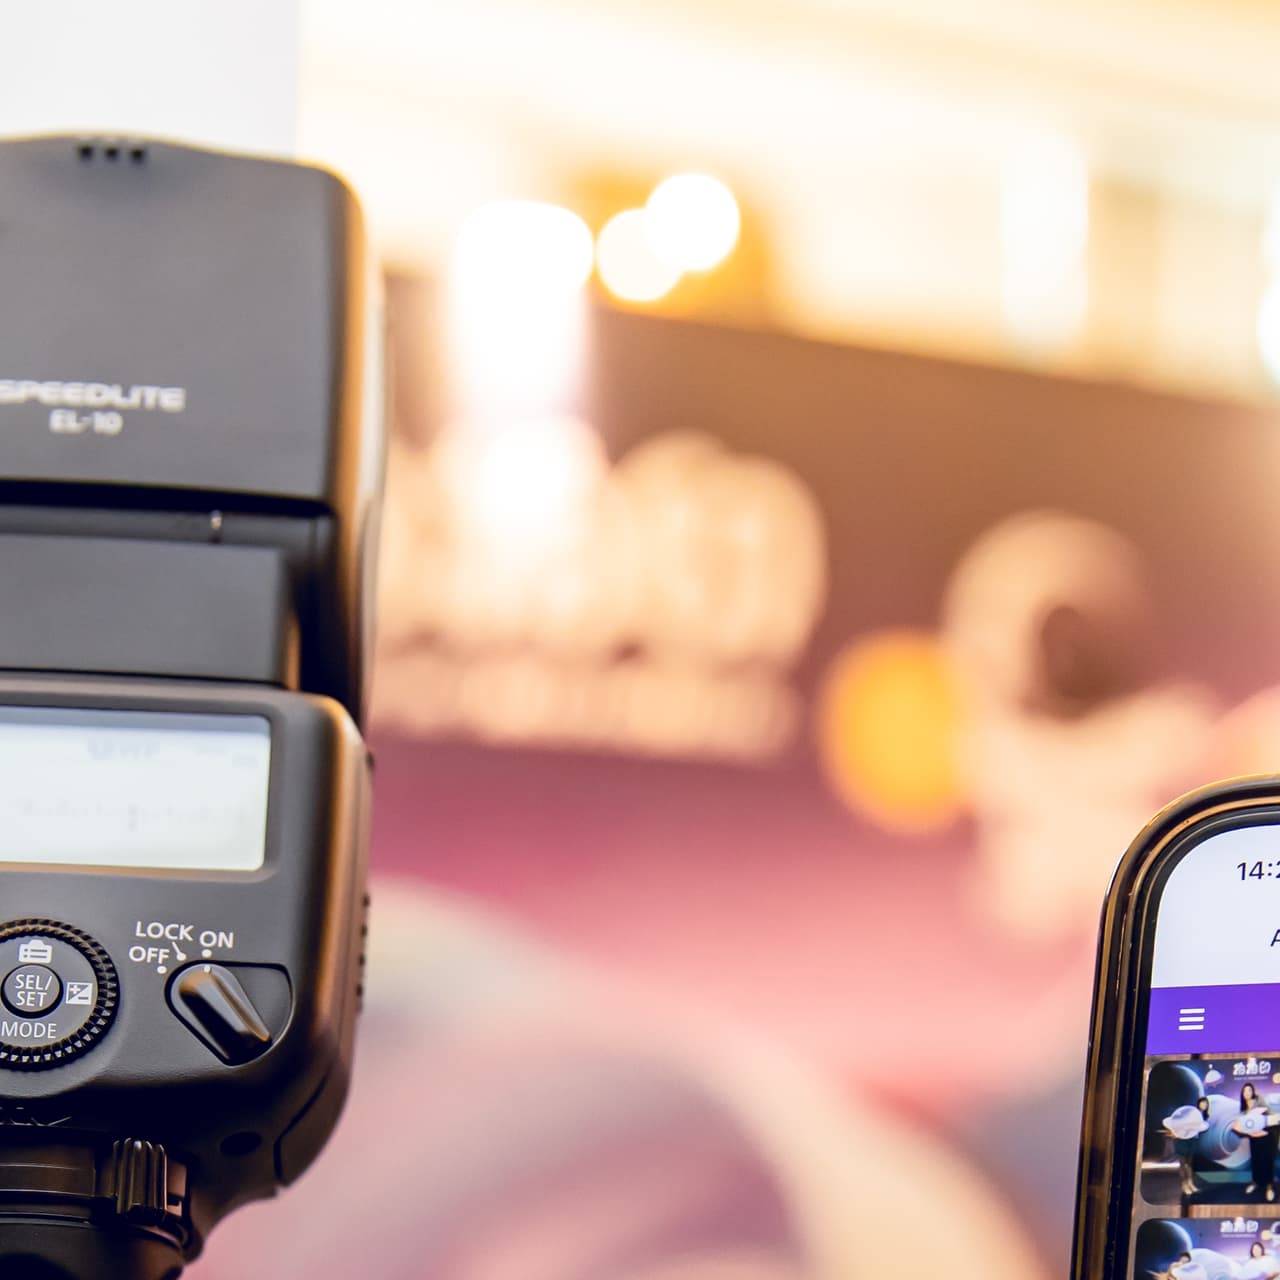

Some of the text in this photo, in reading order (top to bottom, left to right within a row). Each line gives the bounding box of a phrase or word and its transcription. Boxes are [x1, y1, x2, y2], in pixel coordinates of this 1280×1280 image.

[49, 409, 123, 435] EL-10
[135, 920, 195, 941] LOCK
[199, 930, 235, 949] ON
[128, 945, 171, 965] OFF
[15, 973, 53, 991] SEL/
[15, 990, 48, 1007] SET
[1, 1021, 58, 1039] MODE
